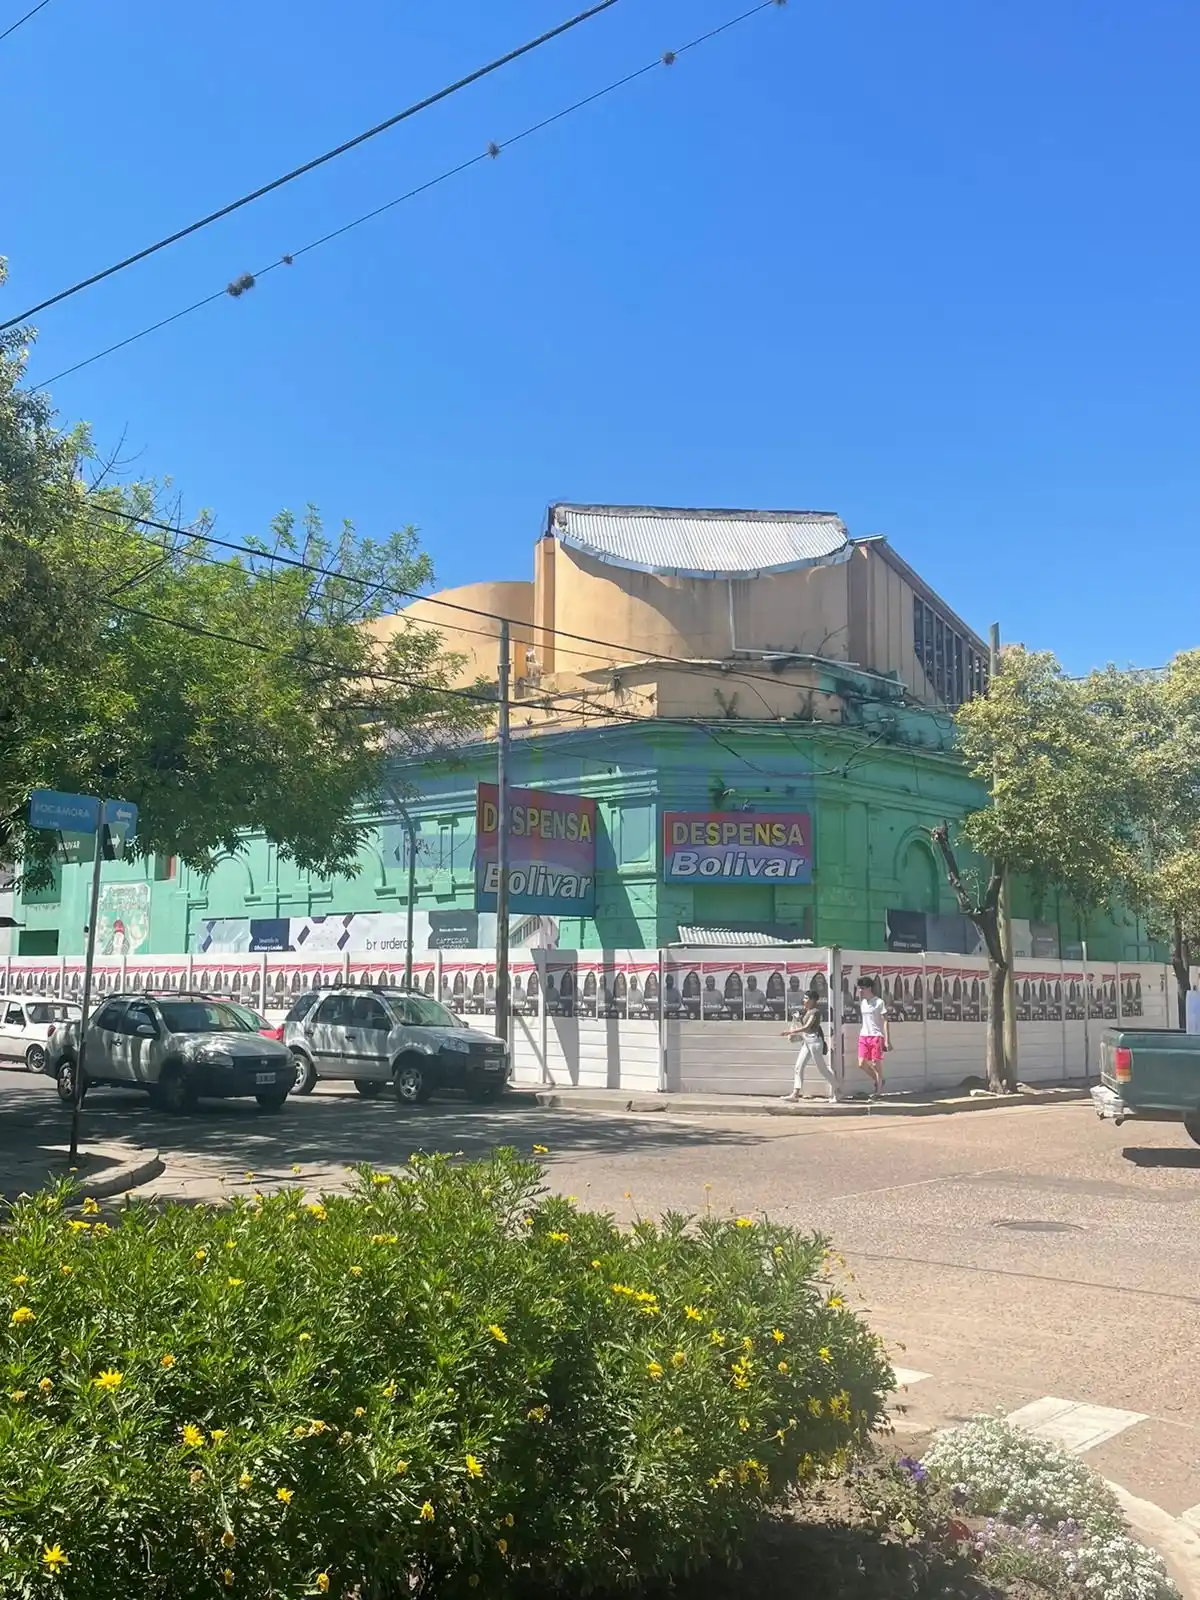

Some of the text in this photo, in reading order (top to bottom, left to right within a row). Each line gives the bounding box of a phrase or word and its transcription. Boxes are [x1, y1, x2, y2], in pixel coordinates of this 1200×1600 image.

[483, 802, 592, 843] DSPENSA
[671, 821, 805, 846] DESPENSA
[483, 861, 593, 899] Bolivar
[670, 850, 806, 878] Bolivar
